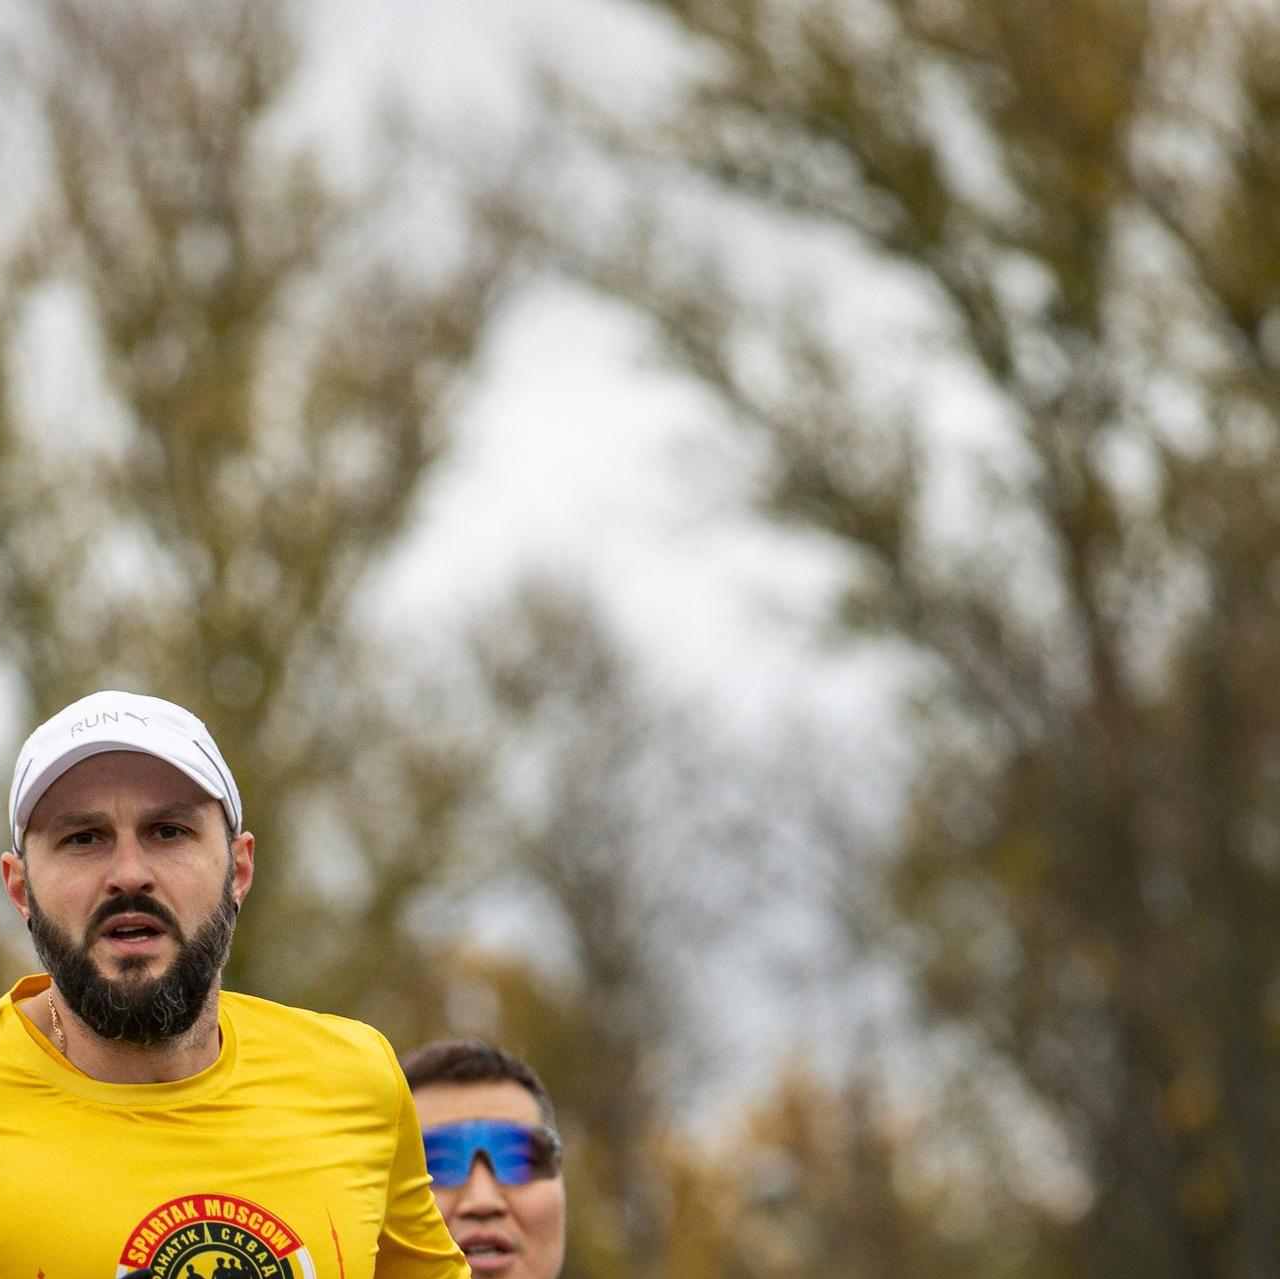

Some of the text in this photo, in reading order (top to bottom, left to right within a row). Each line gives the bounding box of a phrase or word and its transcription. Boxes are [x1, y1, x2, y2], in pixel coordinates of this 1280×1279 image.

[70, 711, 120, 738] RUN
[127, 1199, 293, 1265] SPARTAK MOSCOW
[220, 1227, 279, 1279] СКВАД
